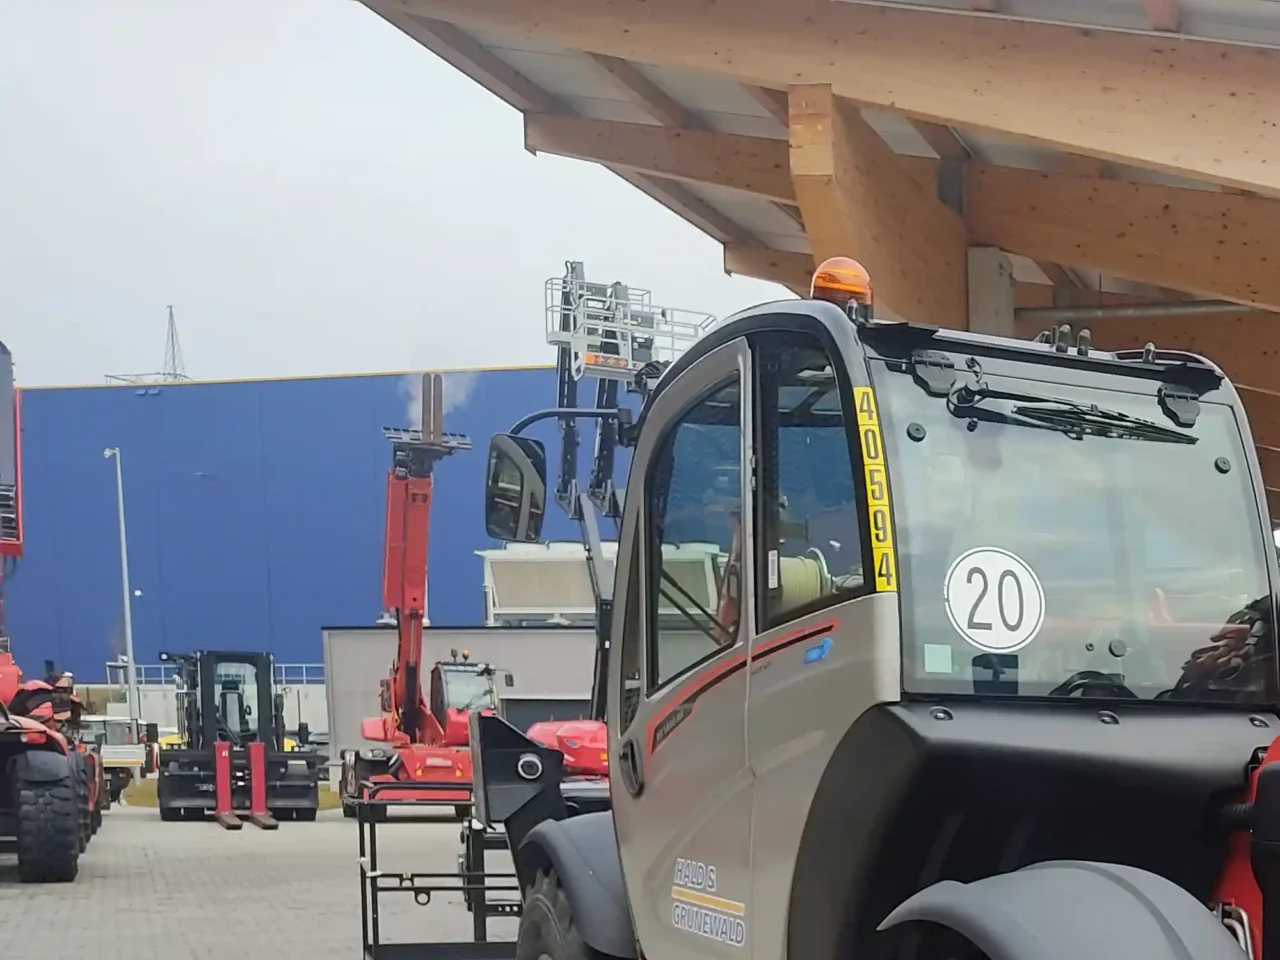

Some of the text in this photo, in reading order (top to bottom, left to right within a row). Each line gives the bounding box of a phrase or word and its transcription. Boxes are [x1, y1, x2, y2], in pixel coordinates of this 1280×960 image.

[859, 390, 894, 587] 40594
[966, 566, 1025, 632] 20
[674, 858, 706, 888] HALD
[672, 902, 746, 946] GRUNEWALD
